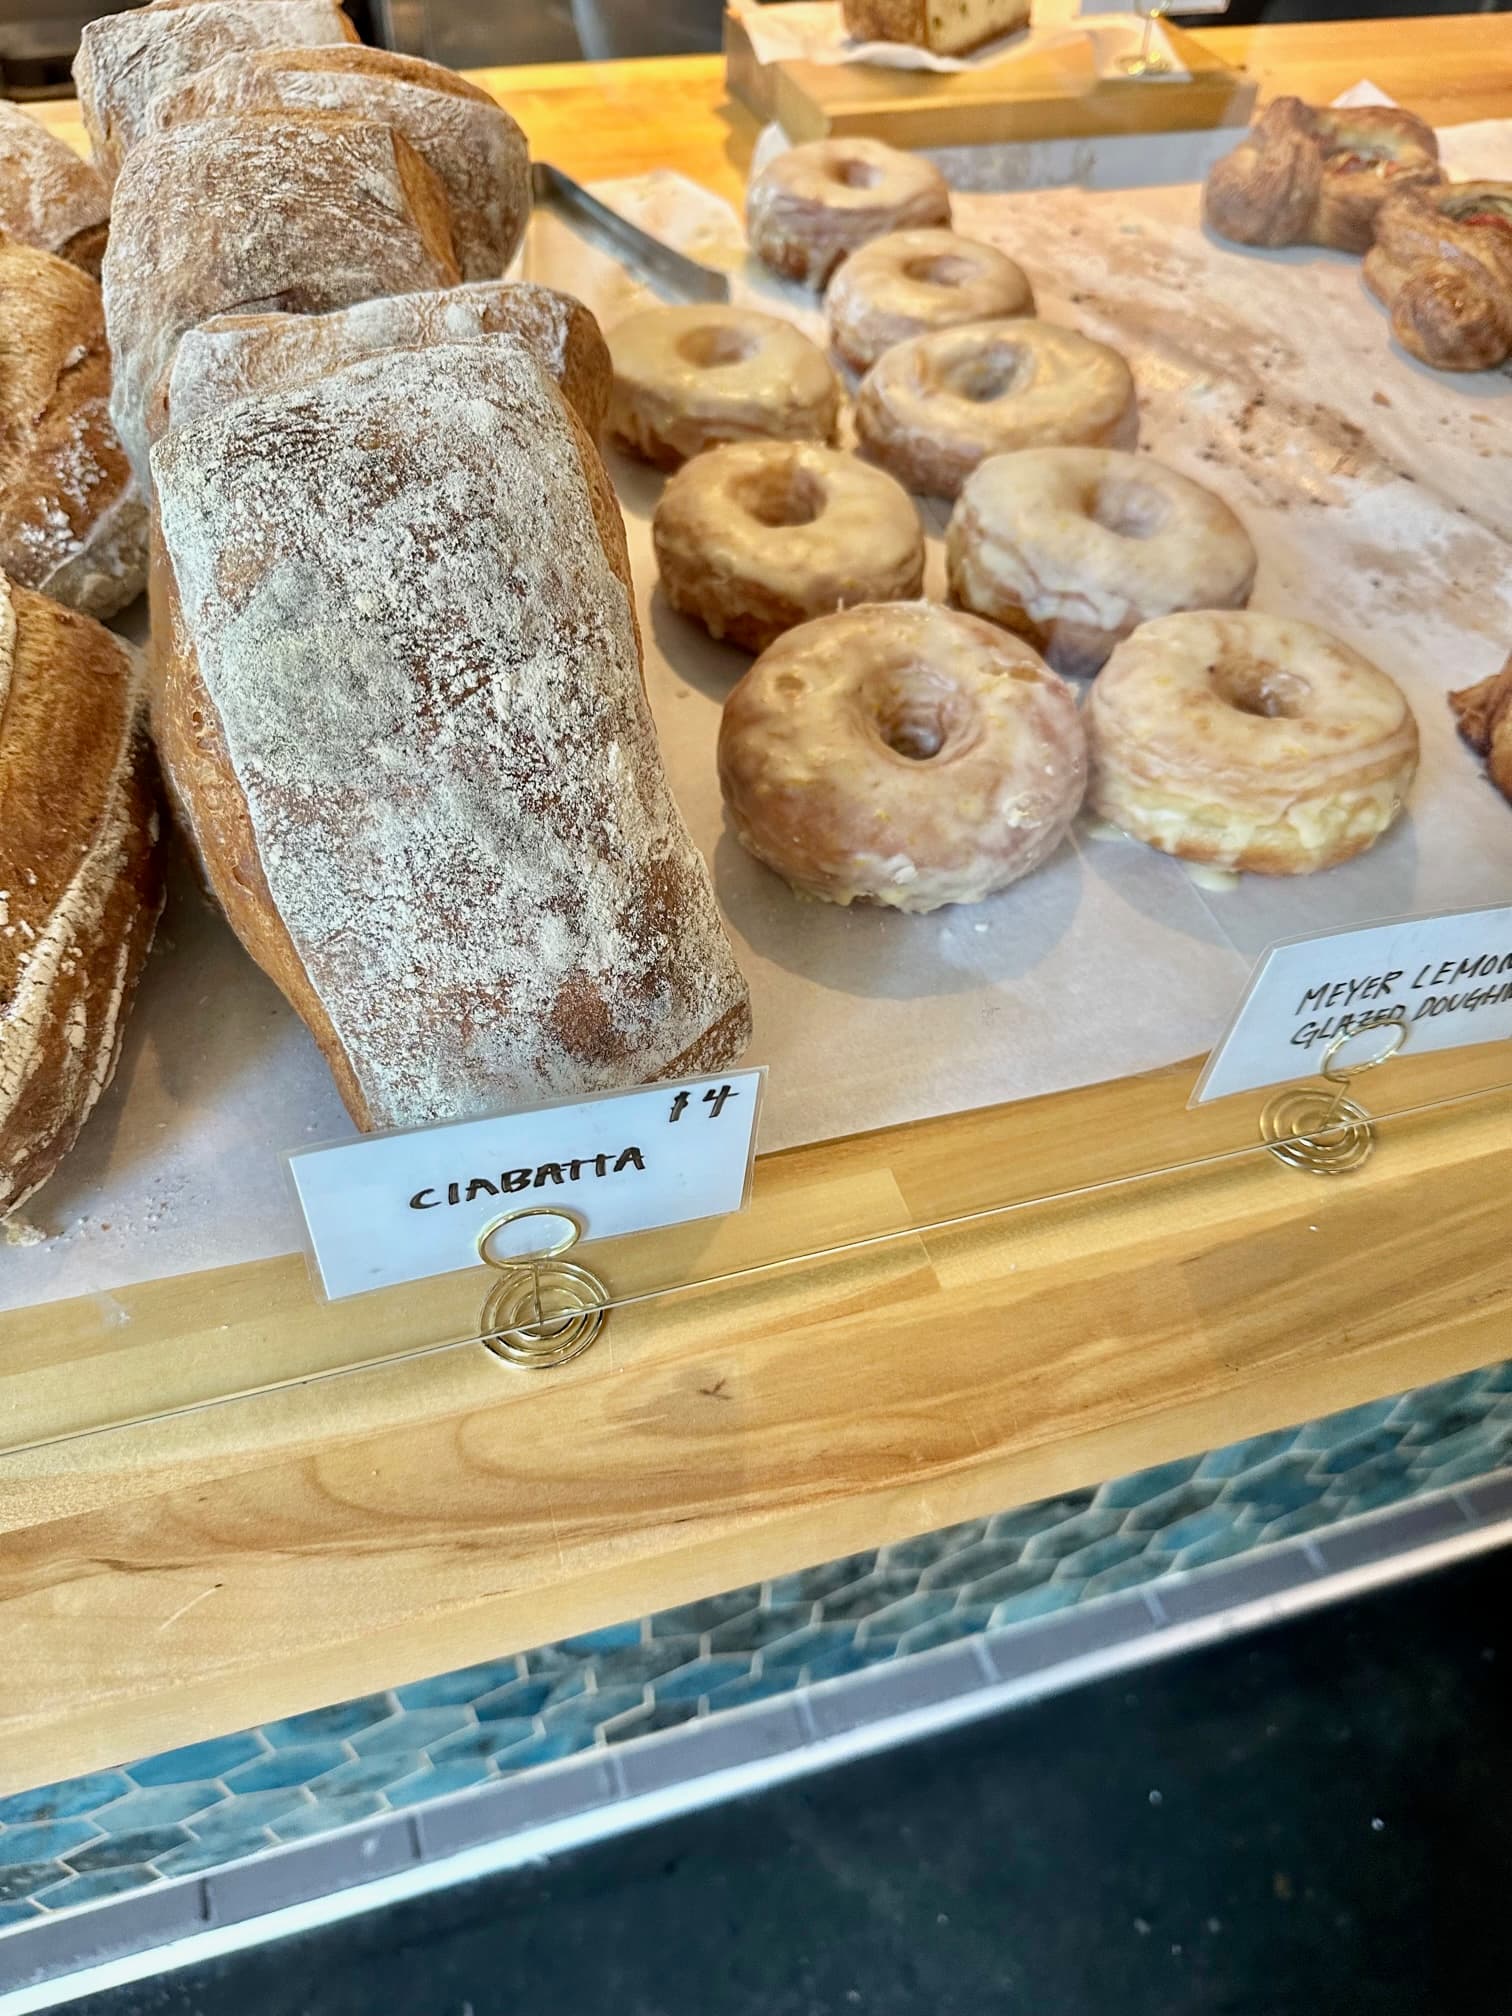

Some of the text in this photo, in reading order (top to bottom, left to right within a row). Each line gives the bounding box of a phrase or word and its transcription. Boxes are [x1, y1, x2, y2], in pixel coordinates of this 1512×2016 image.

[1295, 970, 1404, 1016] MEYER
[1290, 1004, 1406, 1049] GLAZED
[668, 1084, 739, 1123] $4
[409, 1147, 646, 1210] CIABATTA
